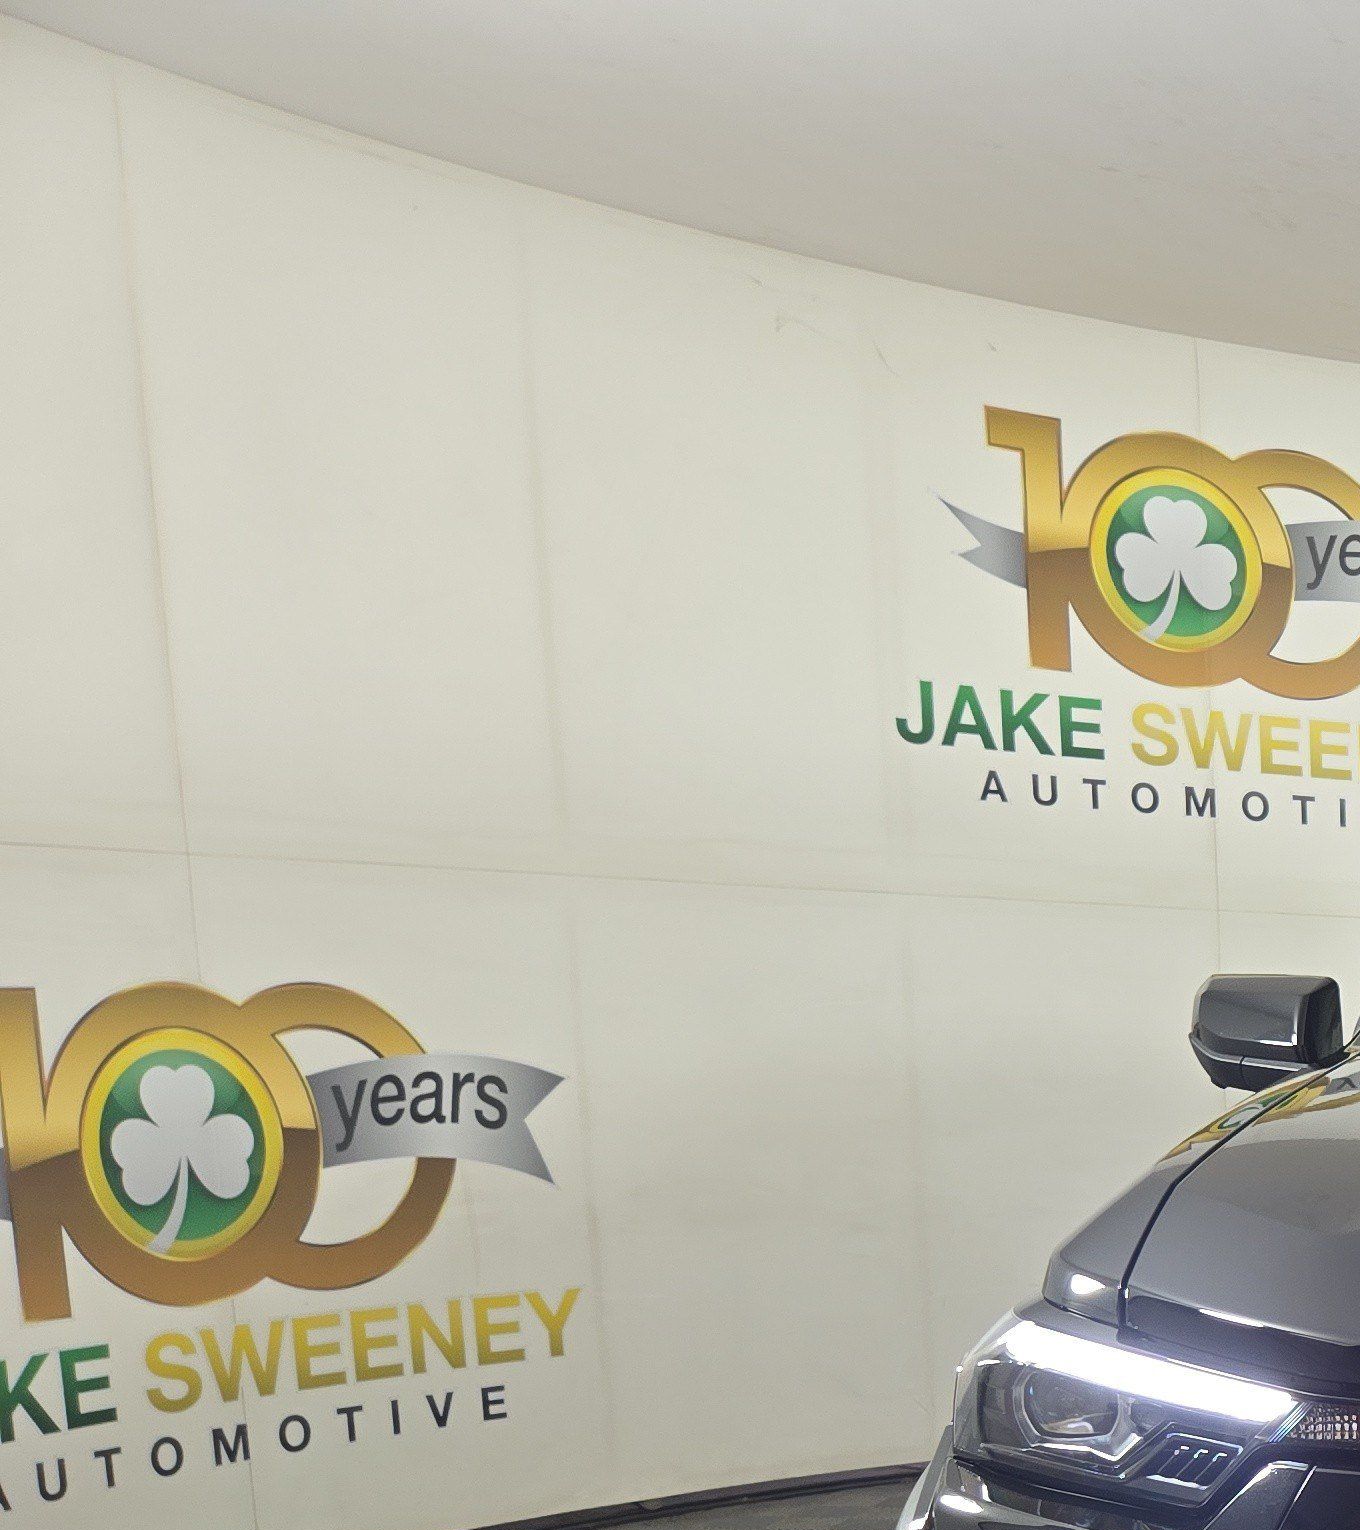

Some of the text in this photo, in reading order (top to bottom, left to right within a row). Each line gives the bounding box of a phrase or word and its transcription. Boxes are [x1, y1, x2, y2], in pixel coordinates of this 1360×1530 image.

[895, 679, 1106, 760] JAKE
[331, 1070, 509, 1152] years
[145, 1288, 581, 1414] SWEENEY
[0, 1385, 508, 1512] UTOMOTIVE
